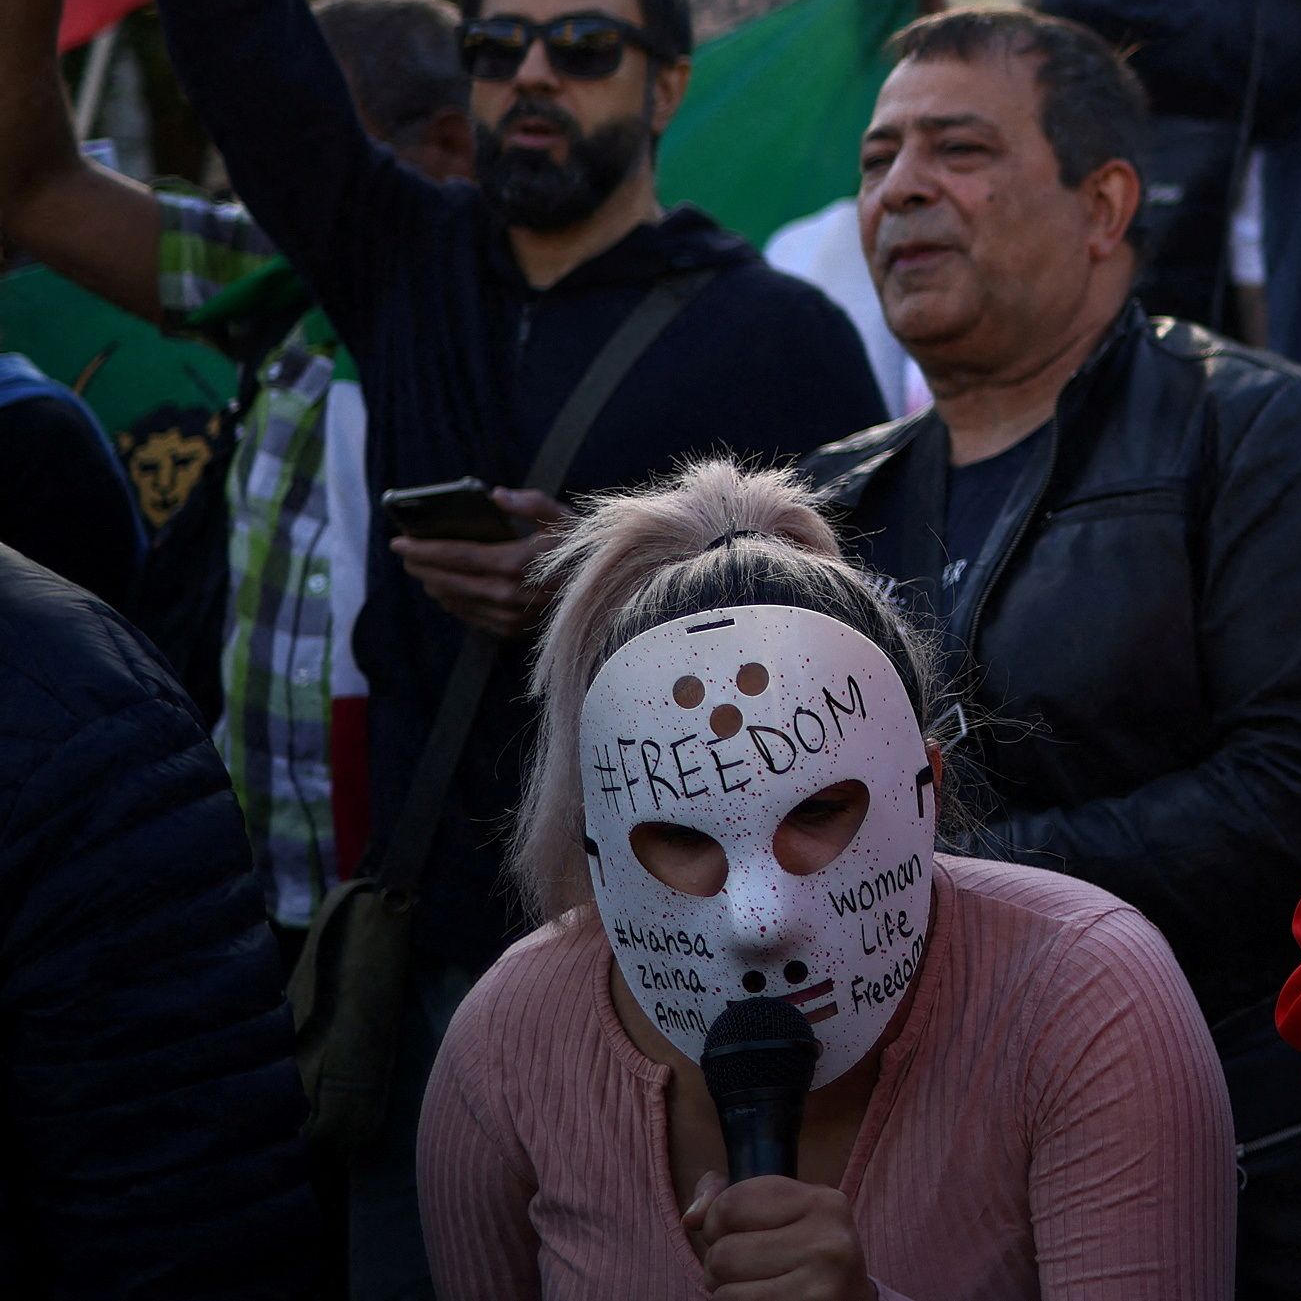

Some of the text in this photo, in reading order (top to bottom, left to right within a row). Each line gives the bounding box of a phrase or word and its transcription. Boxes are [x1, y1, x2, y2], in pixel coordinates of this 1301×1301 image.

[594, 675, 866, 814] #FREEDOM
[614, 918, 714, 959] #Mahsa
[861, 911, 914, 955] Life
[851, 934, 923, 1014] Freedom
[655, 999, 708, 1035] Amini
